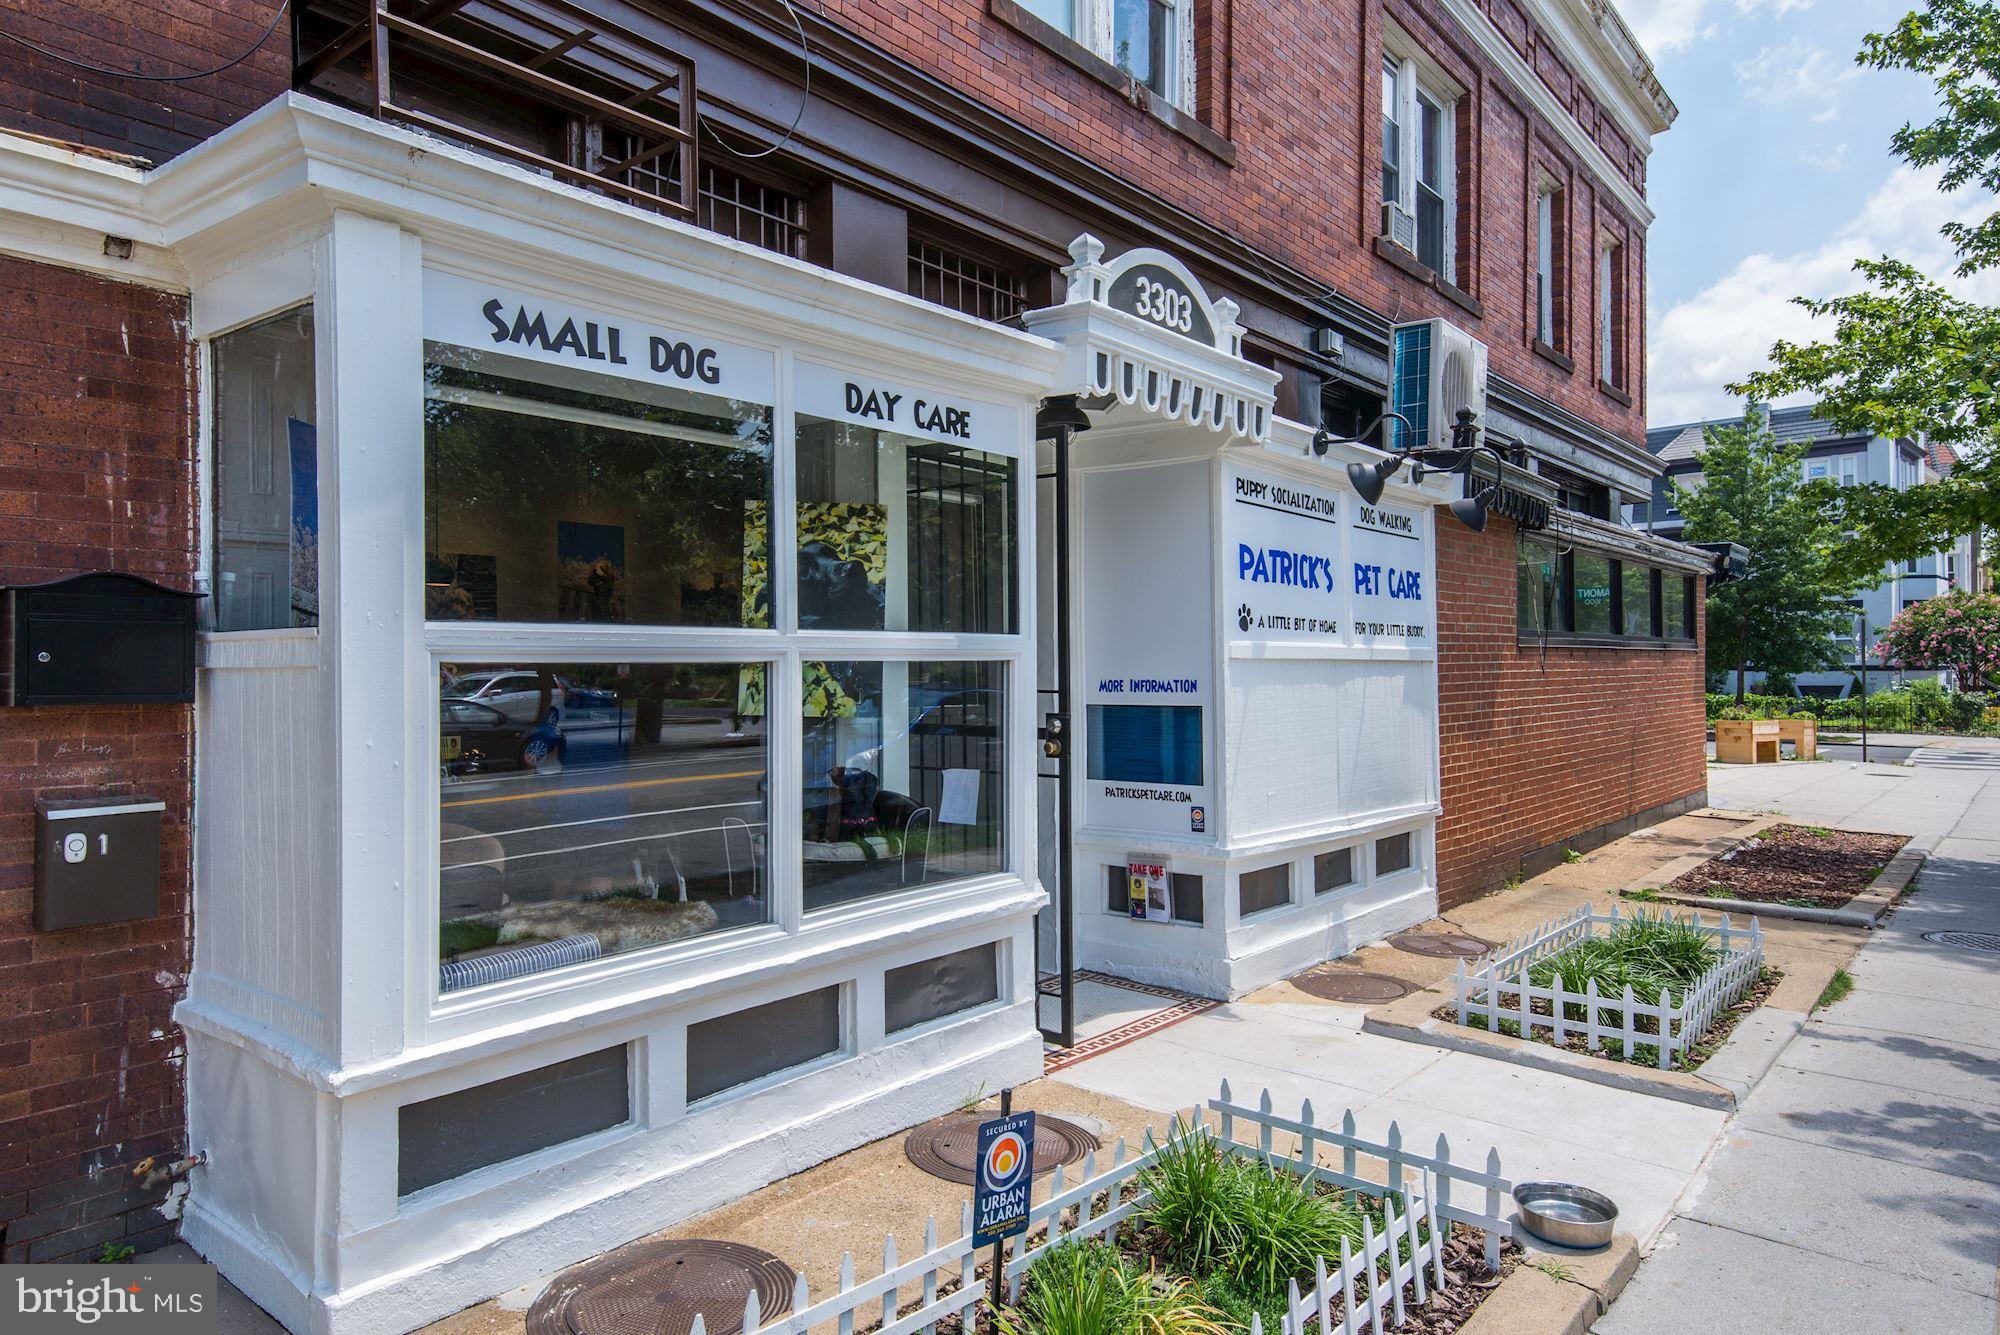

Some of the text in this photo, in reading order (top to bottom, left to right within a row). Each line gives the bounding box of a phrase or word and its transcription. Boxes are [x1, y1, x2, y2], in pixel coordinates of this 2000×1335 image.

[1136, 276, 1193, 333] 3303
[482, 298, 720, 384] SMALL DOG
[845, 382, 971, 439] DAY CARE
[1236, 477, 1335, 516] PUPPY SOCIALIZATION
[1360, 506, 1412, 533] DOG WALKING
[1239, 543, 1334, 594] PATRICK'S
[1354, 562, 1421, 600] PET CARE
[1258, 615, 1337, 634] A LITTLE BIT OF HOME
[1355, 622, 1366, 635] FOR
[1368, 623, 1385, 636] YOUR
[1386, 624, 1404, 637] LITTLE
[1098, 678, 1197, 693] MORE INFORMATION
[1105, 787, 1192, 803] PATRICKSPETCARE.COM
[97, 832, 109, 856] 1
[1129, 863, 1164, 877] TAKE ONE
[986, 1119, 1028, 1137] SECURED BY
[982, 1186, 1025, 1212] URBAN
[980, 1201, 1025, 1228] ALARM
